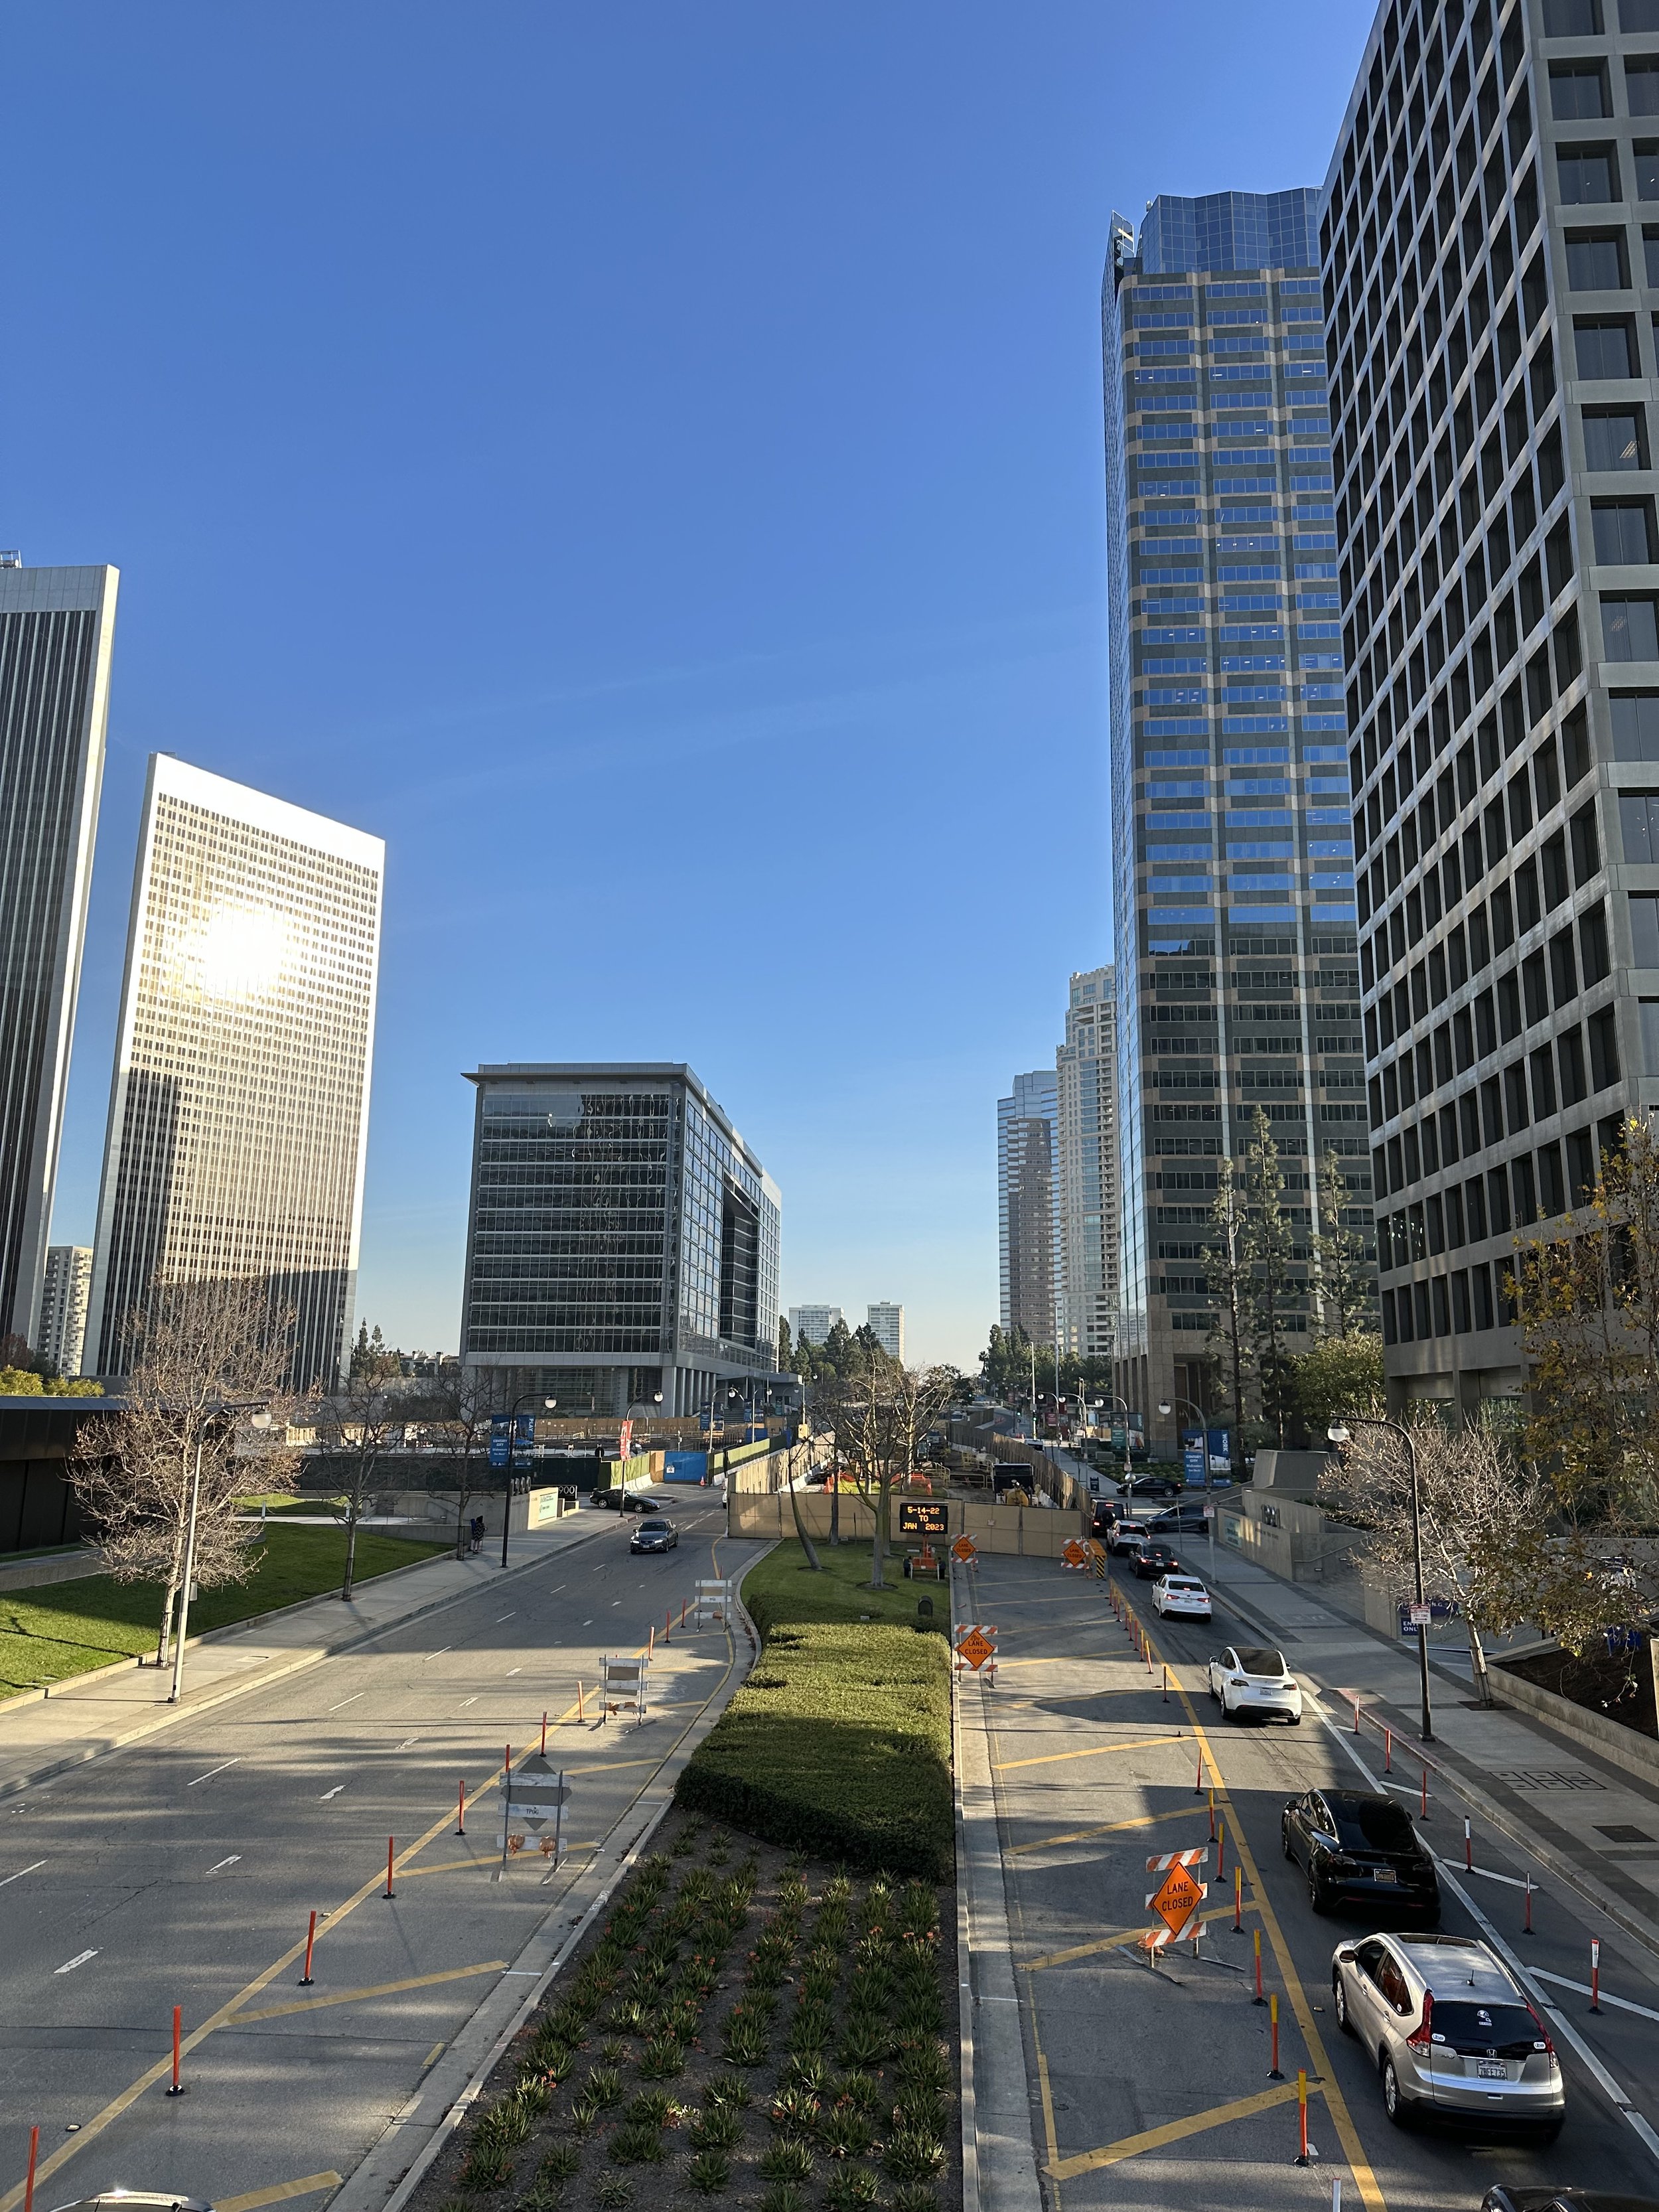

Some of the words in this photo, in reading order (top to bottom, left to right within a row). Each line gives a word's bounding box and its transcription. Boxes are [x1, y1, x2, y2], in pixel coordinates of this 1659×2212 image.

[907, 1506, 940, 1514] 5-14-22
[1167, 1881, 1189, 1895] LANE
[1162, 1896, 1193, 1911] CLOSED
